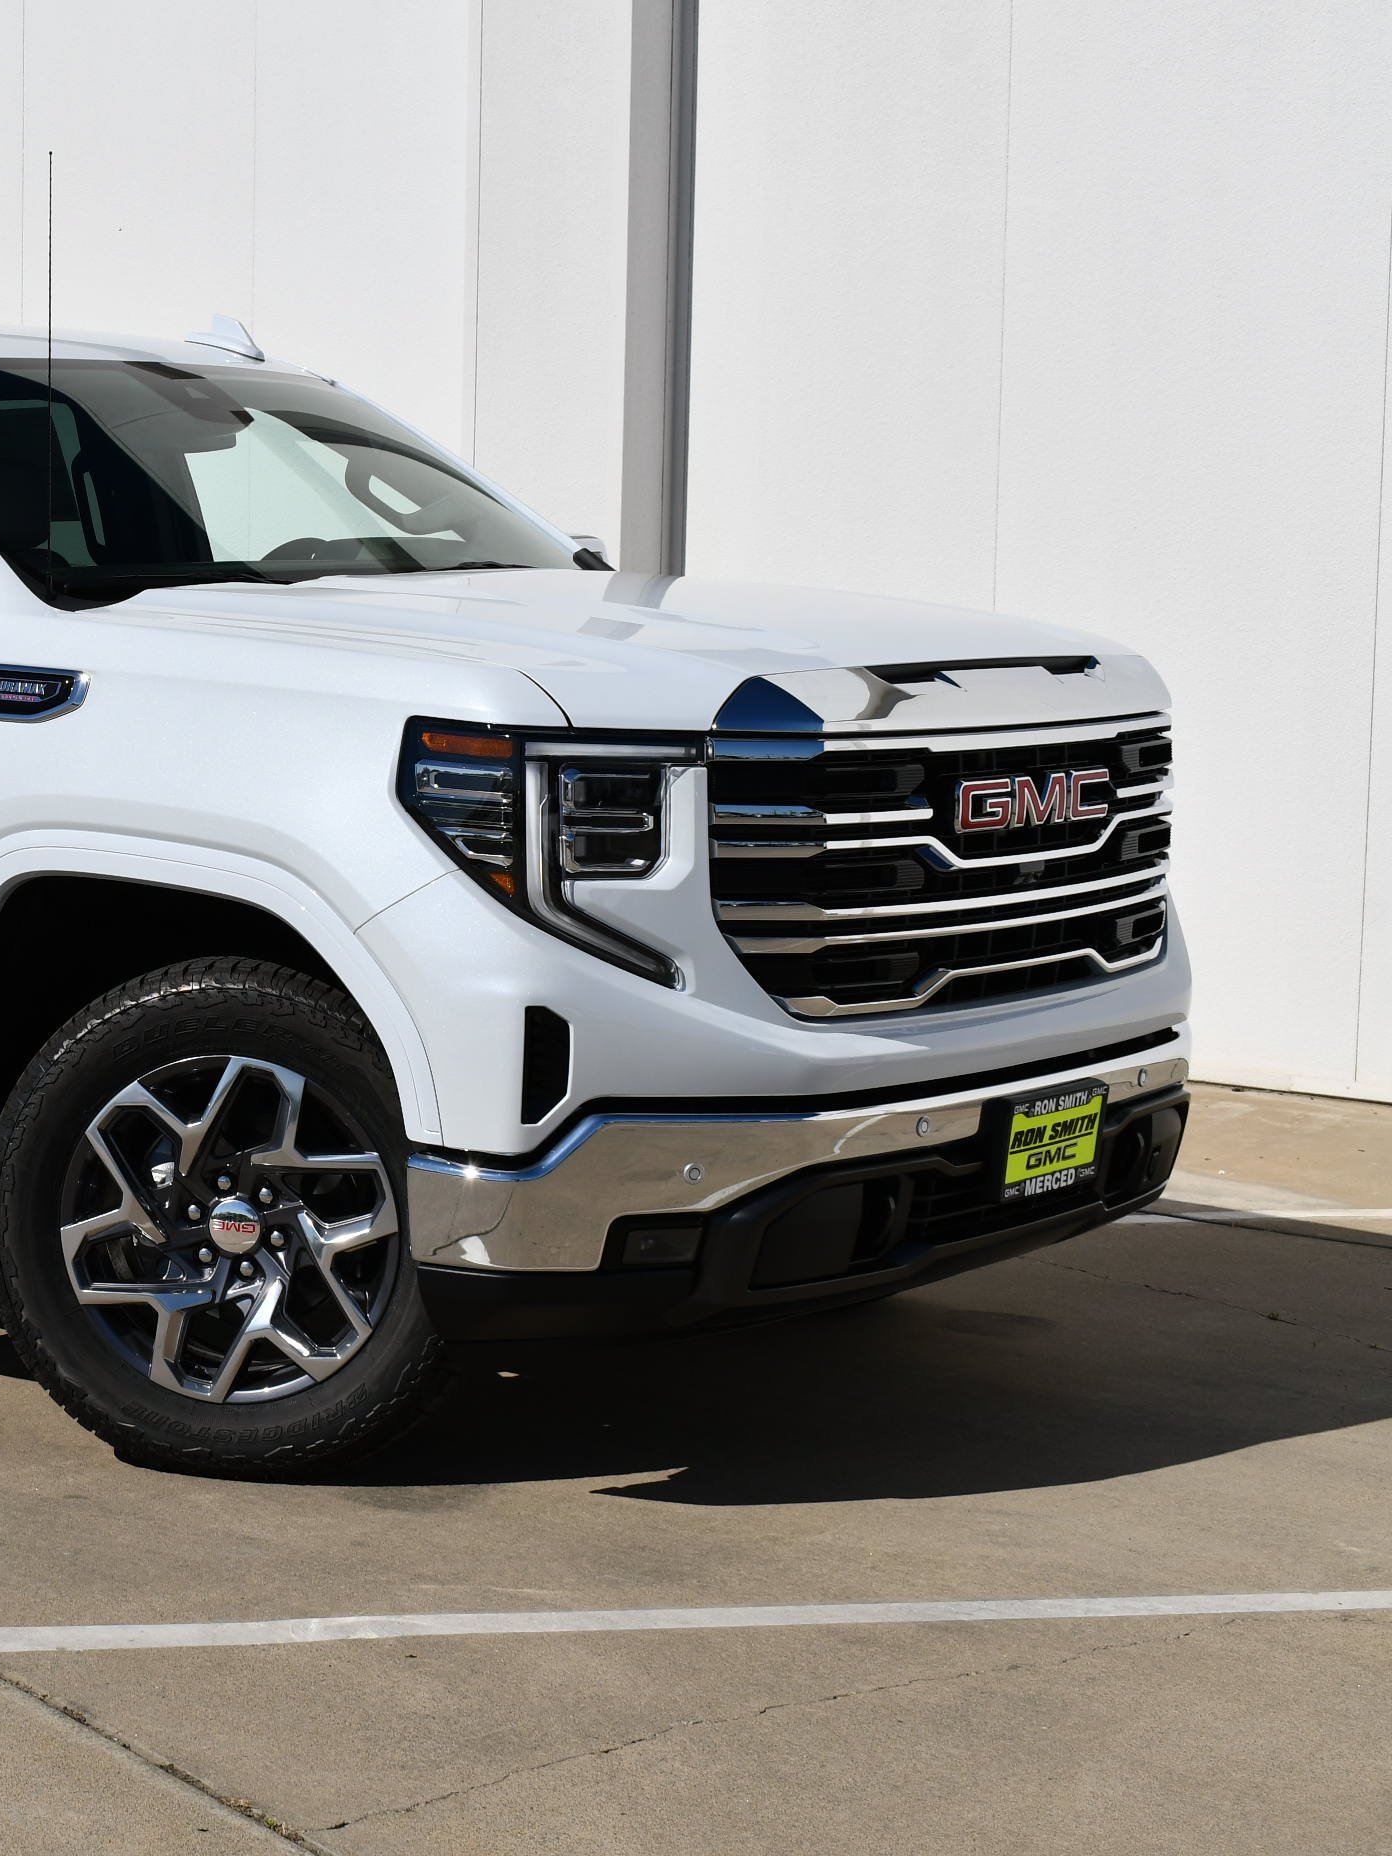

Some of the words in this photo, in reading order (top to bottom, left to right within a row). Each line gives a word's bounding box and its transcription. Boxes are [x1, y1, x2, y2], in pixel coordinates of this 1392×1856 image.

[955, 768, 1110, 833] GMC
[1014, 1103, 1029, 1114] GMC
[1034, 1098, 1055, 1115] RON
[1058, 1091, 1088, 1109] SMITH
[1092, 1086, 1107, 1095] GMC
[1011, 1125, 1047, 1149] RON
[1050, 1112, 1098, 1140] SMITH
[1026, 1143, 1078, 1170] GMC
[1005, 1186, 1020, 1197] GMC
[1025, 1168, 1075, 1196] MERCED
[1079, 1166, 1095, 1177] GMC
[212, 1220, 256, 1233] GMC
